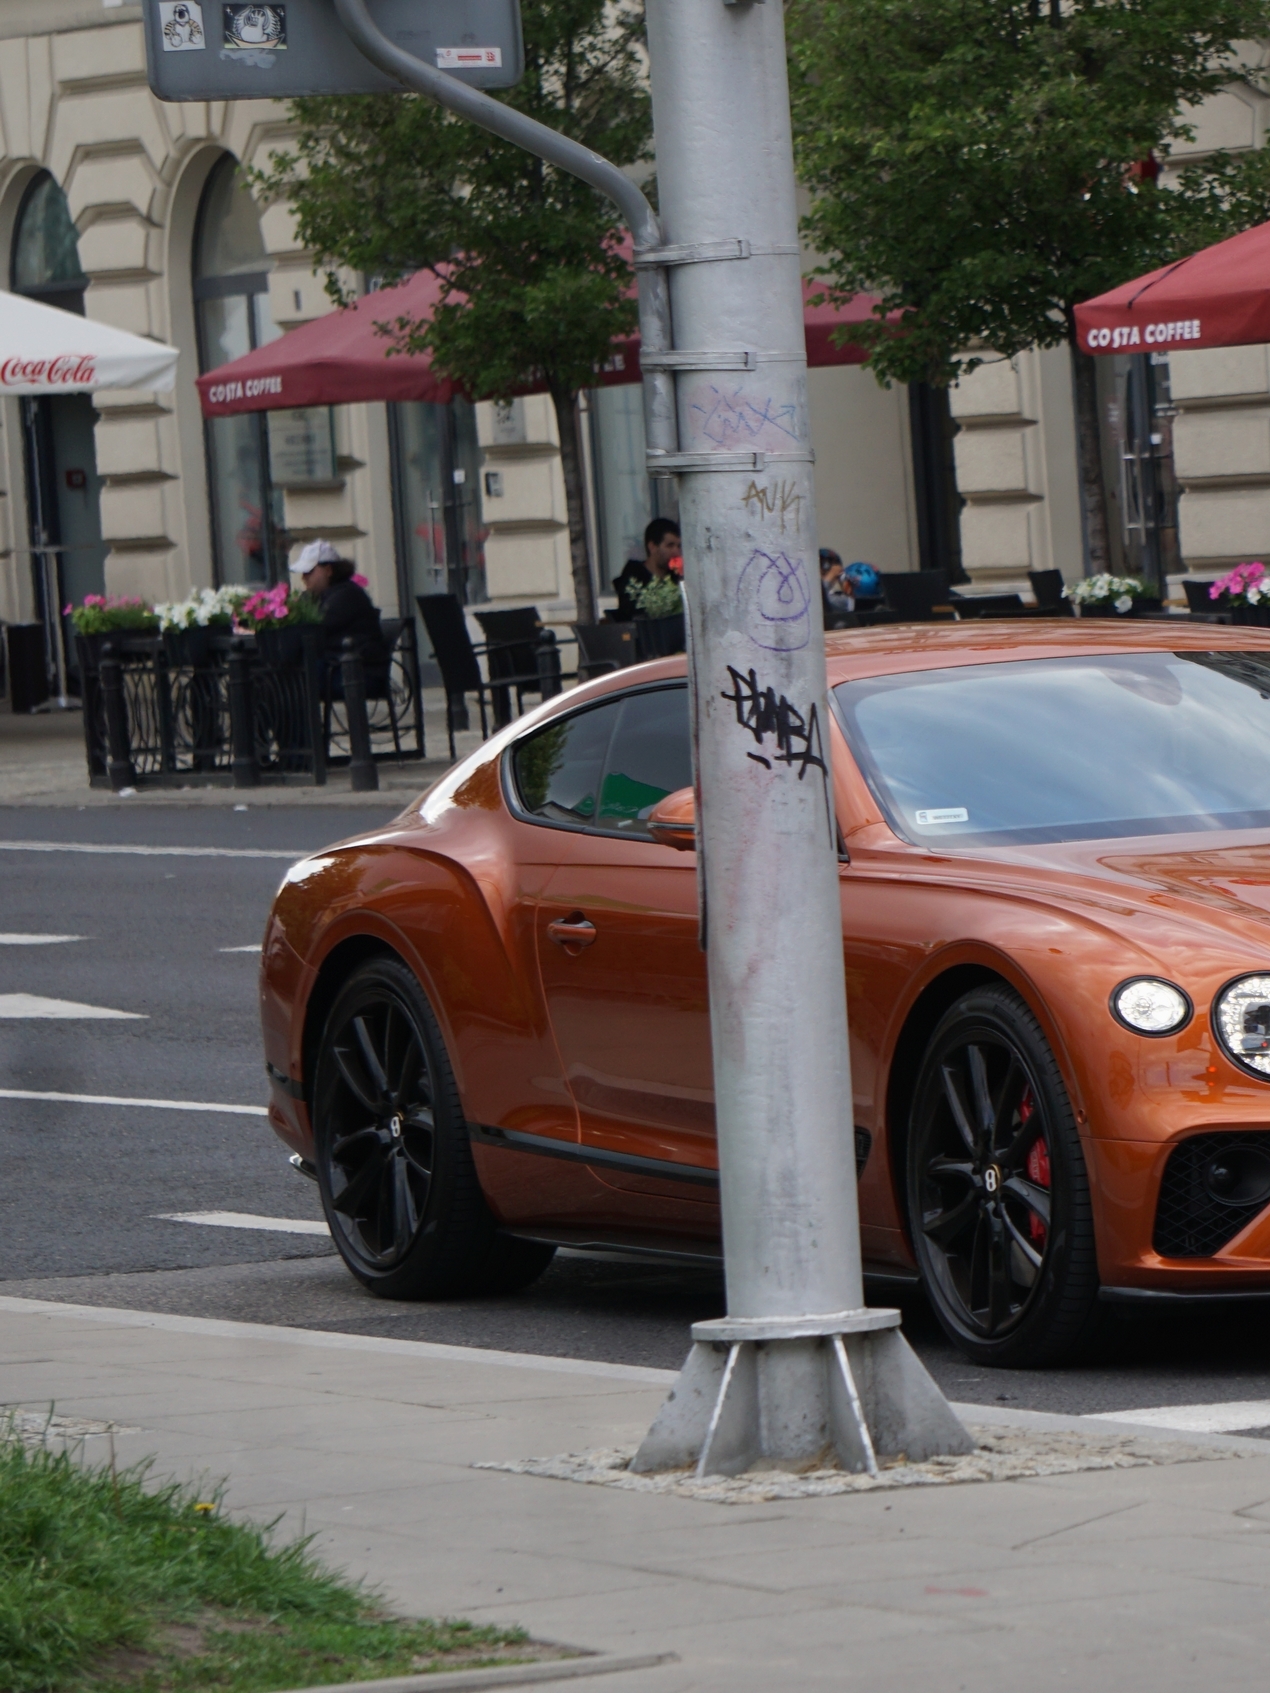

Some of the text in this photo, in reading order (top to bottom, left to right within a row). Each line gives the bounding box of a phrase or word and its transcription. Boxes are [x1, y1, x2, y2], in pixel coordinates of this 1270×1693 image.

[1087, 319, 1201, 348] COSTA COFFEE
[209, 376, 282, 403] COSTA COFFEE
